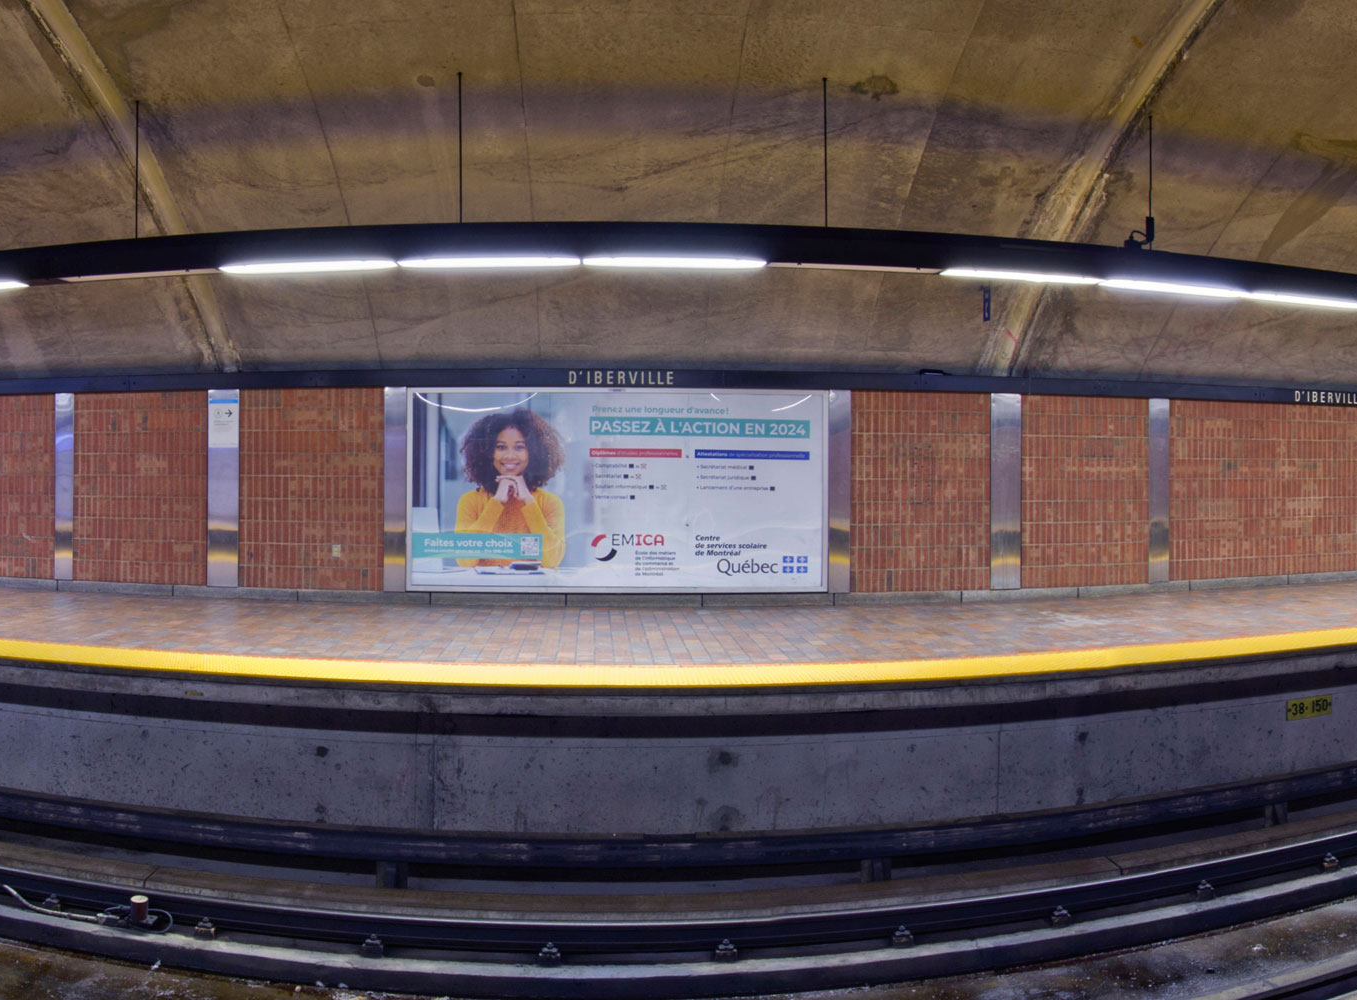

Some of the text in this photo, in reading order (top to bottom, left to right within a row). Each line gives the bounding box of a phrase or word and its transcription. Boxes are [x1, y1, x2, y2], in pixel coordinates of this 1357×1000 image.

[568, 371, 674, 385] D'IBERVILLE
[592, 405, 622, 413] Prenez
[644, 406, 684, 415] longueur
[686, 406, 729, 415] d'avance!
[591, 418, 806, 435] PASSEZ À L'ACTION EN 2024
[424, 538, 513, 548] Faites votre choix
[611, 533, 665, 546] EMICA
[716, 558, 779, 576] Québec
[1312, 699, 1328, 713] 150
